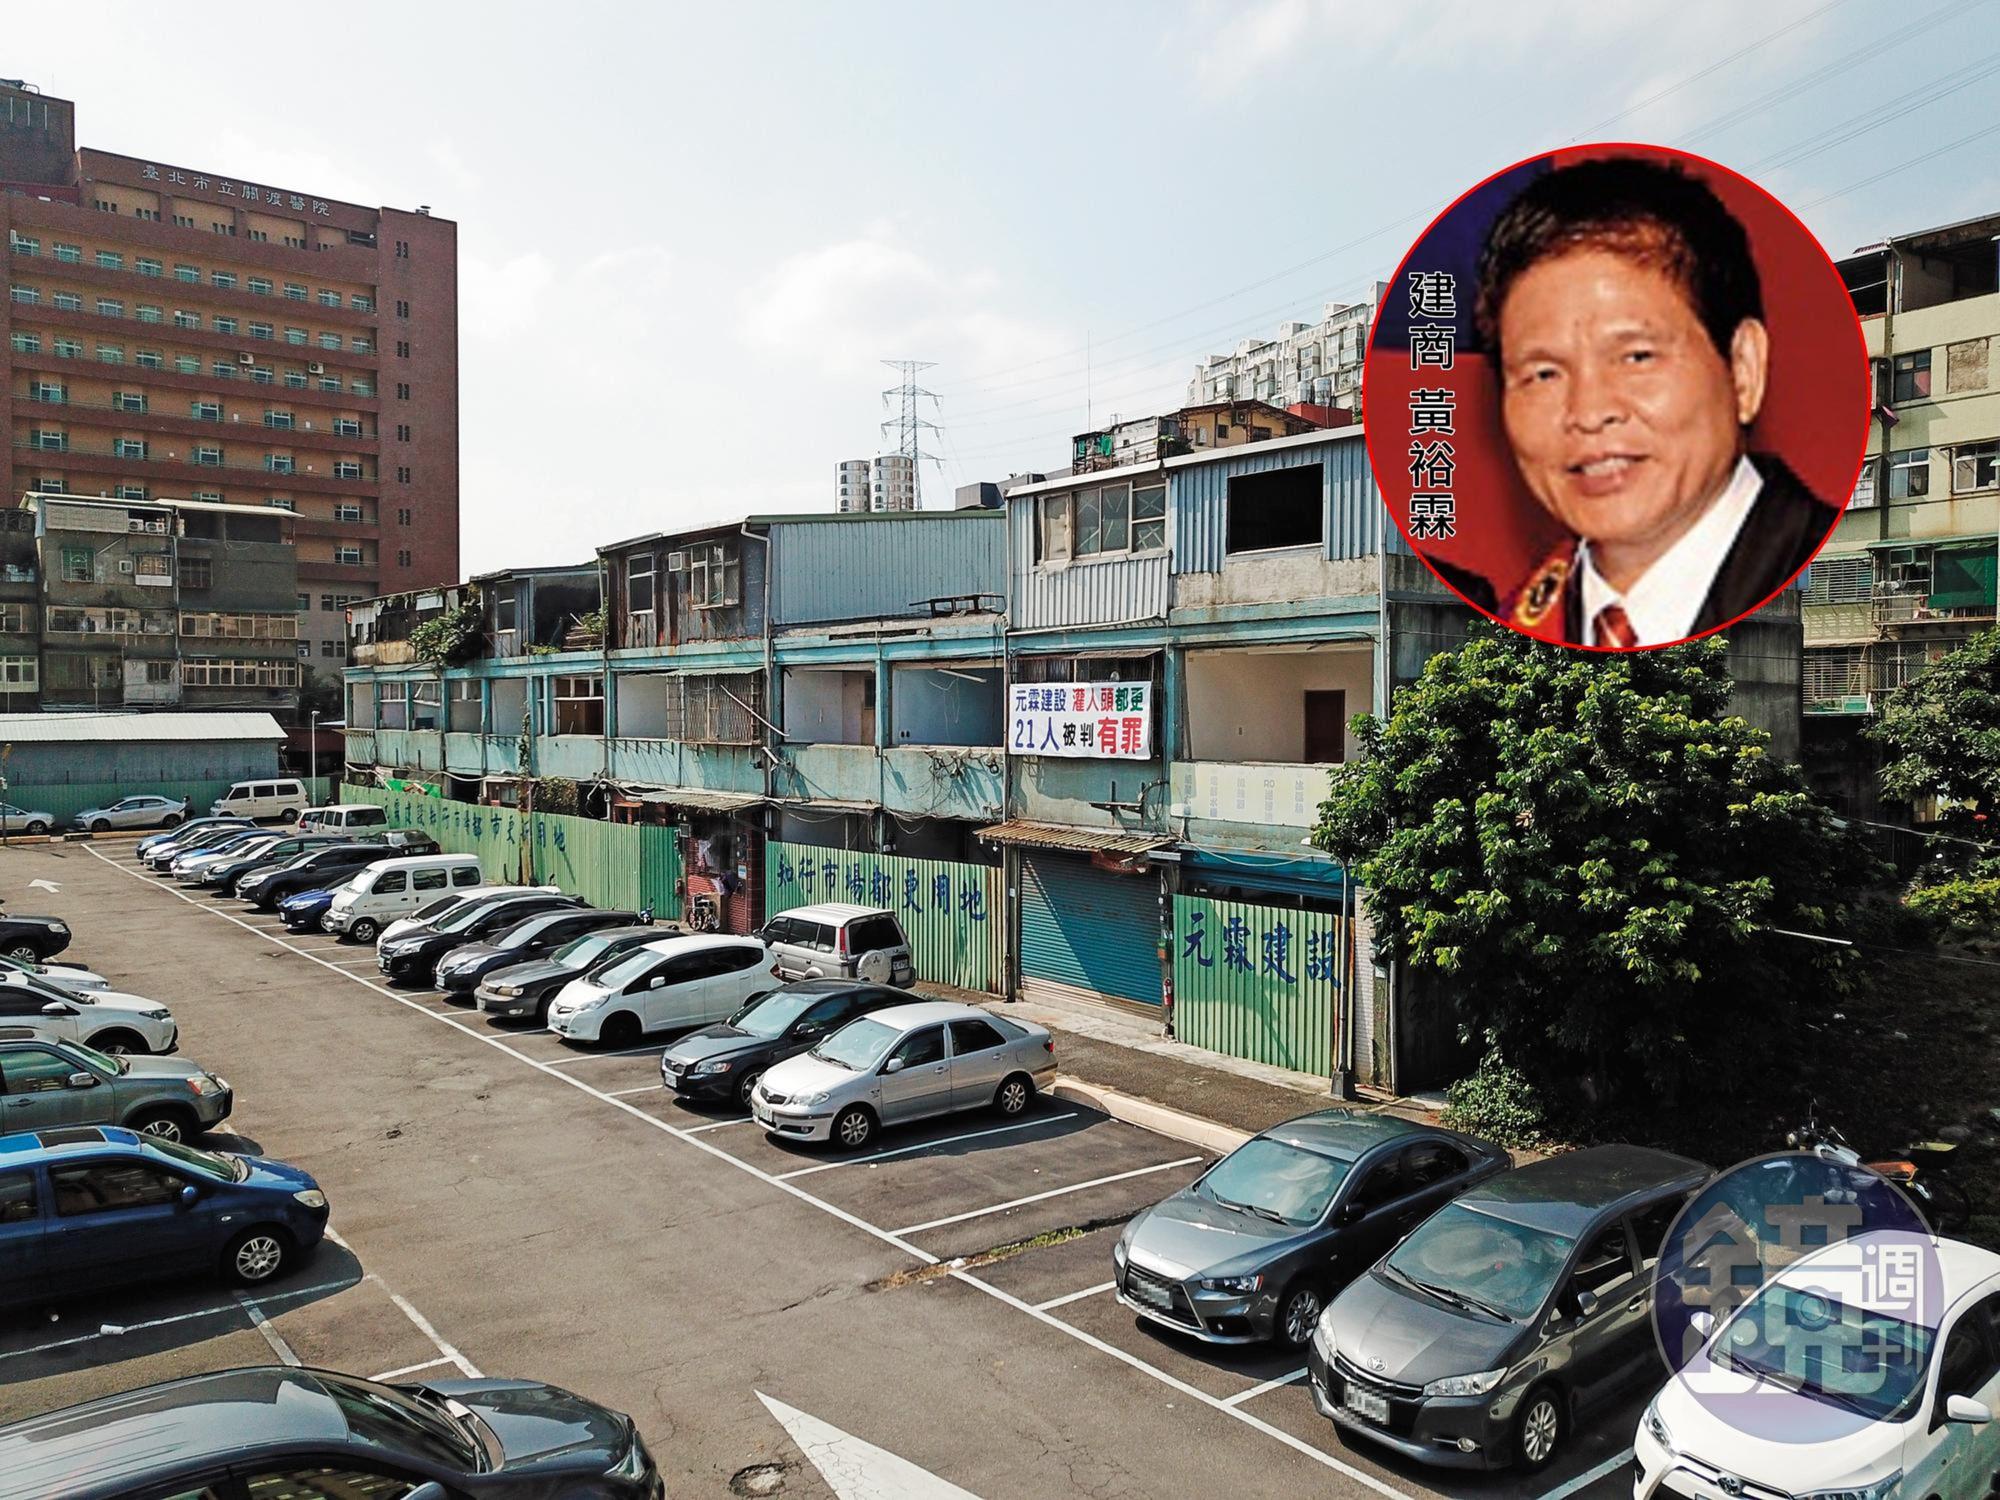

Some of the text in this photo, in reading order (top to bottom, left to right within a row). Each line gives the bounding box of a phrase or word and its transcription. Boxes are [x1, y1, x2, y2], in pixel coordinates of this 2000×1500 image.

[142, 164, 331, 217] 臺北市立關渡醫院
[1015, 687, 1144, 712] 元霖建設 灌人頭都更
[1015, 716, 1142, 755] 21人被判有罪
[776, 853, 987, 921] 知行市場都更用地
[1182, 912, 1341, 989] 元霖建設
